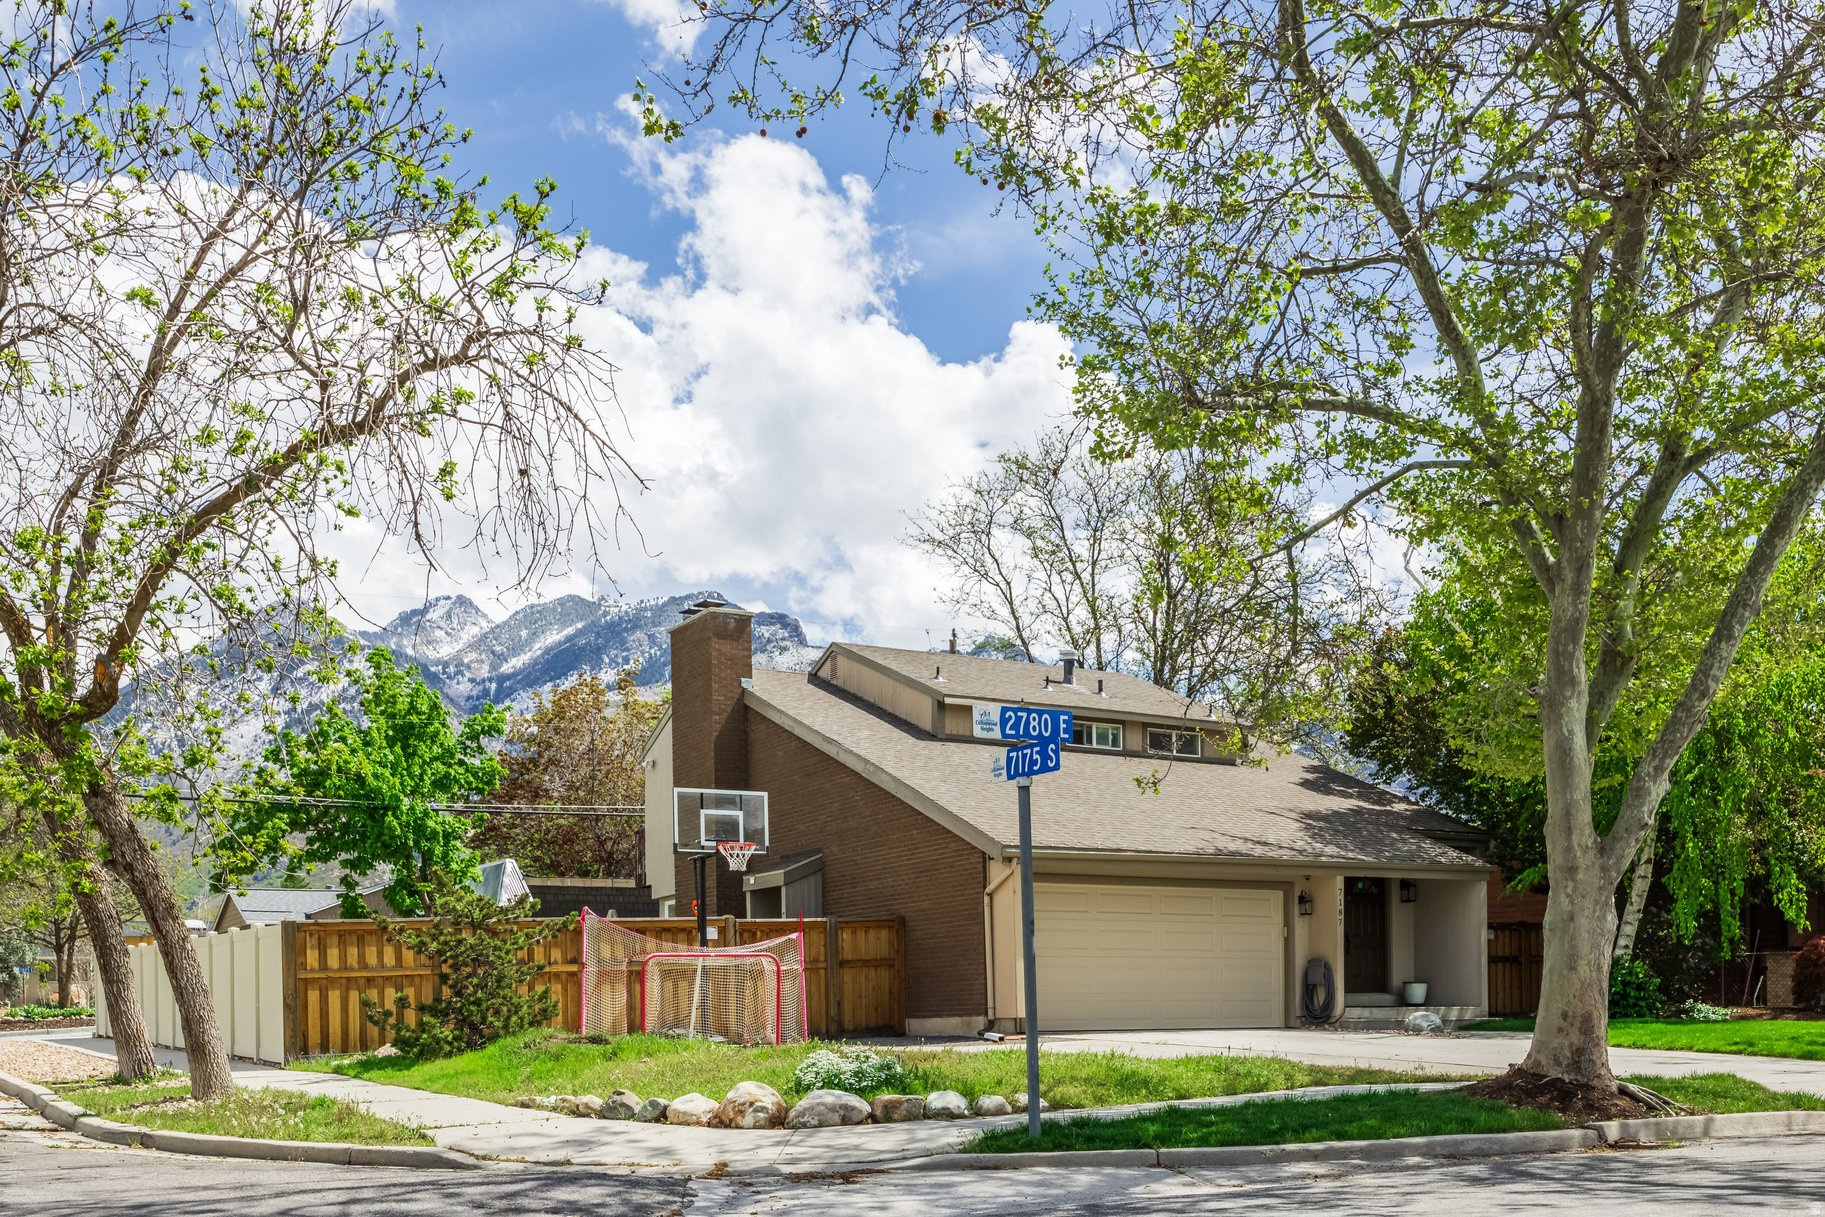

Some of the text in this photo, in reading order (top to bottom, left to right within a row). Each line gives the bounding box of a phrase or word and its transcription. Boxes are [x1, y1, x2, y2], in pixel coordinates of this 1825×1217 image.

[1005, 711, 1069, 738] 2780 E
[1009, 743, 1056, 775] 7175 S
